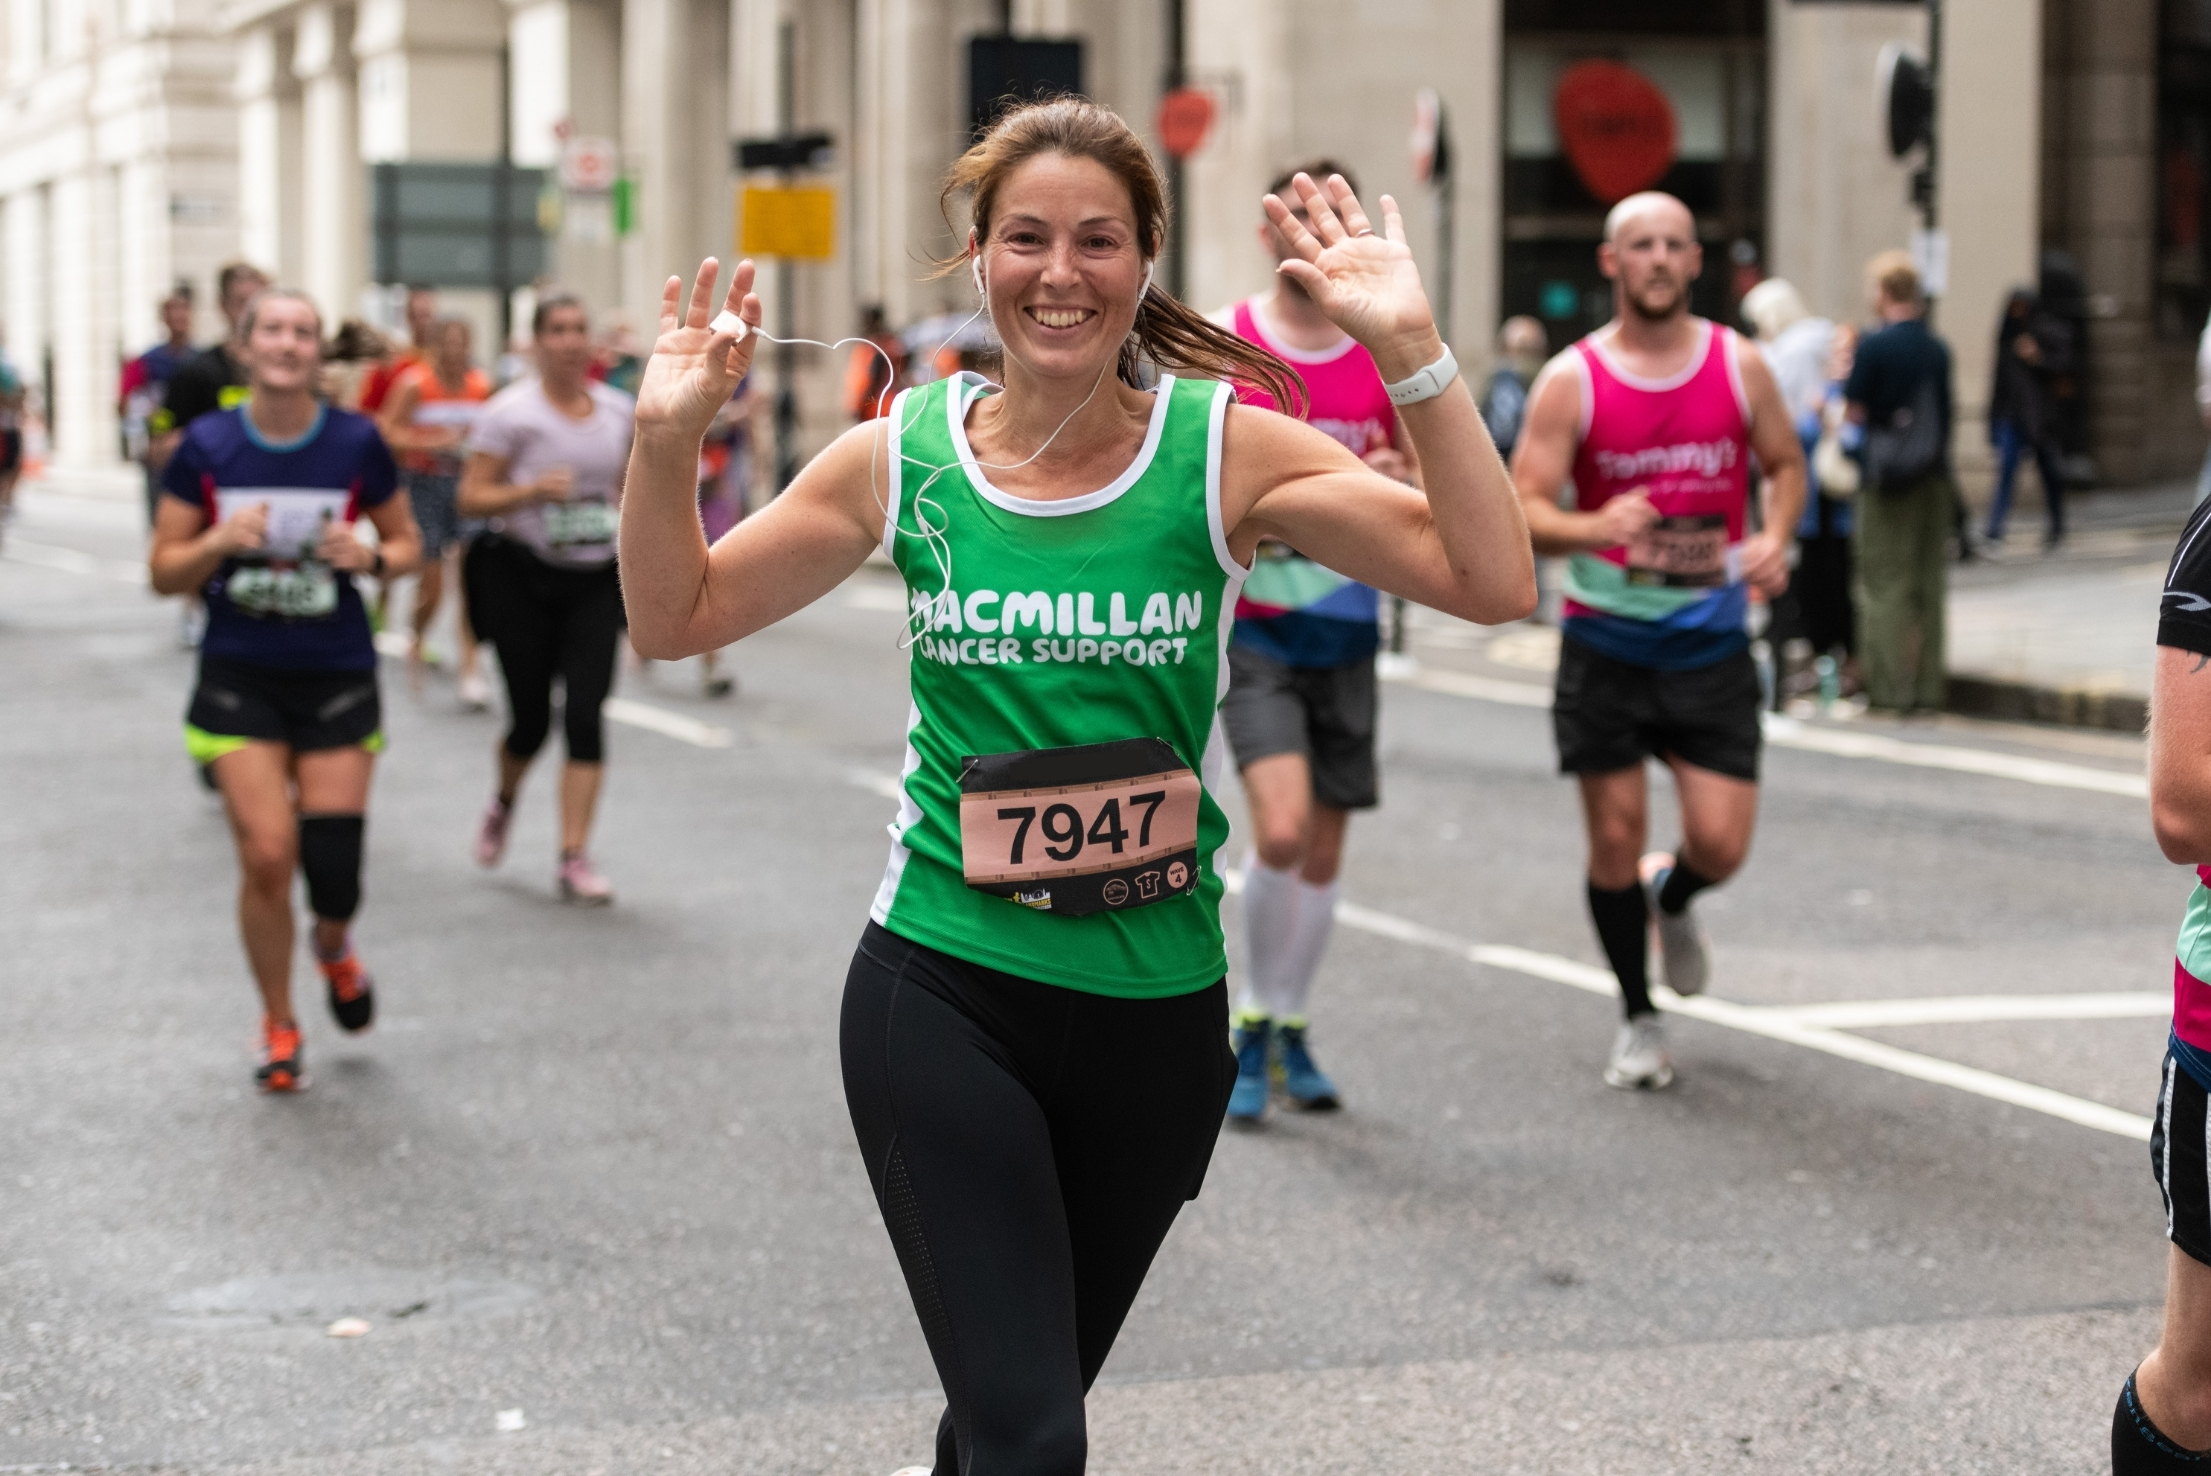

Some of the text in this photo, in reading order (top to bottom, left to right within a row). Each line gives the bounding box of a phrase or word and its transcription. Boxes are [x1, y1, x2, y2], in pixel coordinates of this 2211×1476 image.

[1033, 638, 1188, 666] SUPPORT
[997, 791, 1166, 864] 7947
[1169, 866, 1184, 876] WAVE
[1175, 874, 1181, 883] 4
[1146, 879, 1151, 889] S
